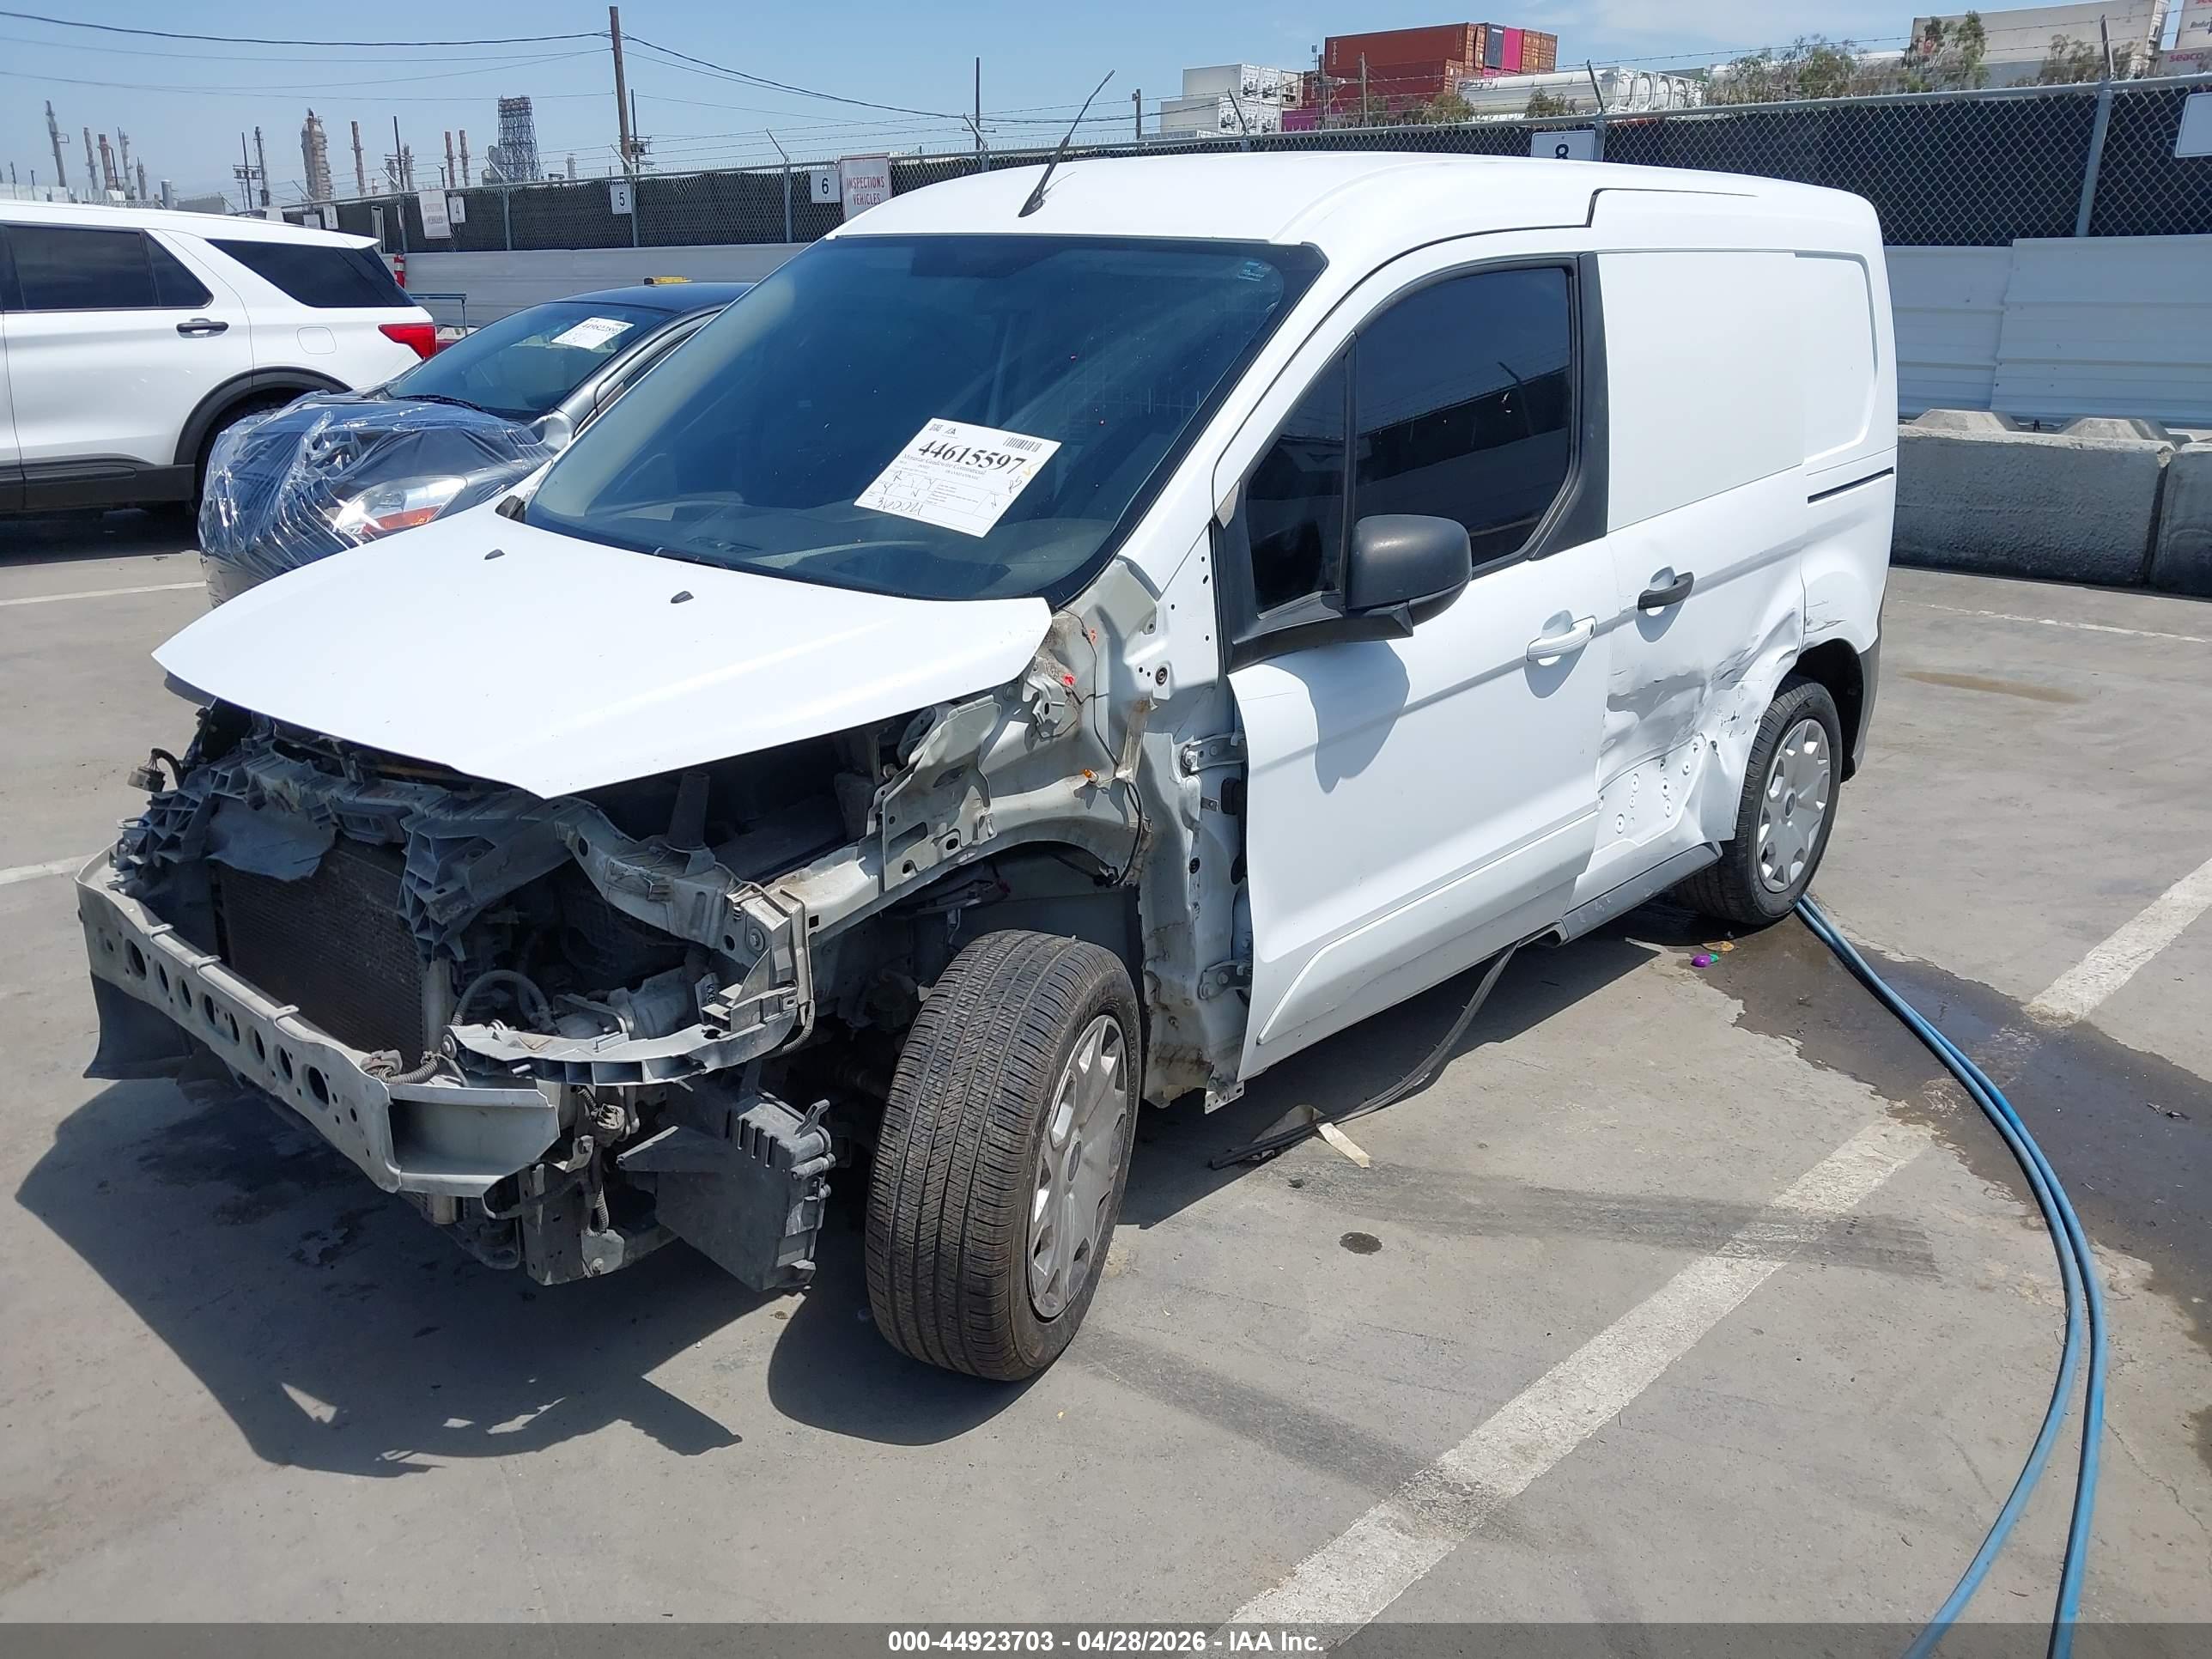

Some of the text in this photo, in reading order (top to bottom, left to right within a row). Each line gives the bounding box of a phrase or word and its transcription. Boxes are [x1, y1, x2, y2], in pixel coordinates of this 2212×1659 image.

[2169, 53, 2204, 62] seaco
[822, 178, 830, 194] 6
[846, 176, 885, 190] INSPECTIONS
[619, 191, 625, 207] 5
[852, 193, 881, 205] VEHICLES
[455, 203, 460, 216] 4
[918, 441, 1026, 474] 44615597
